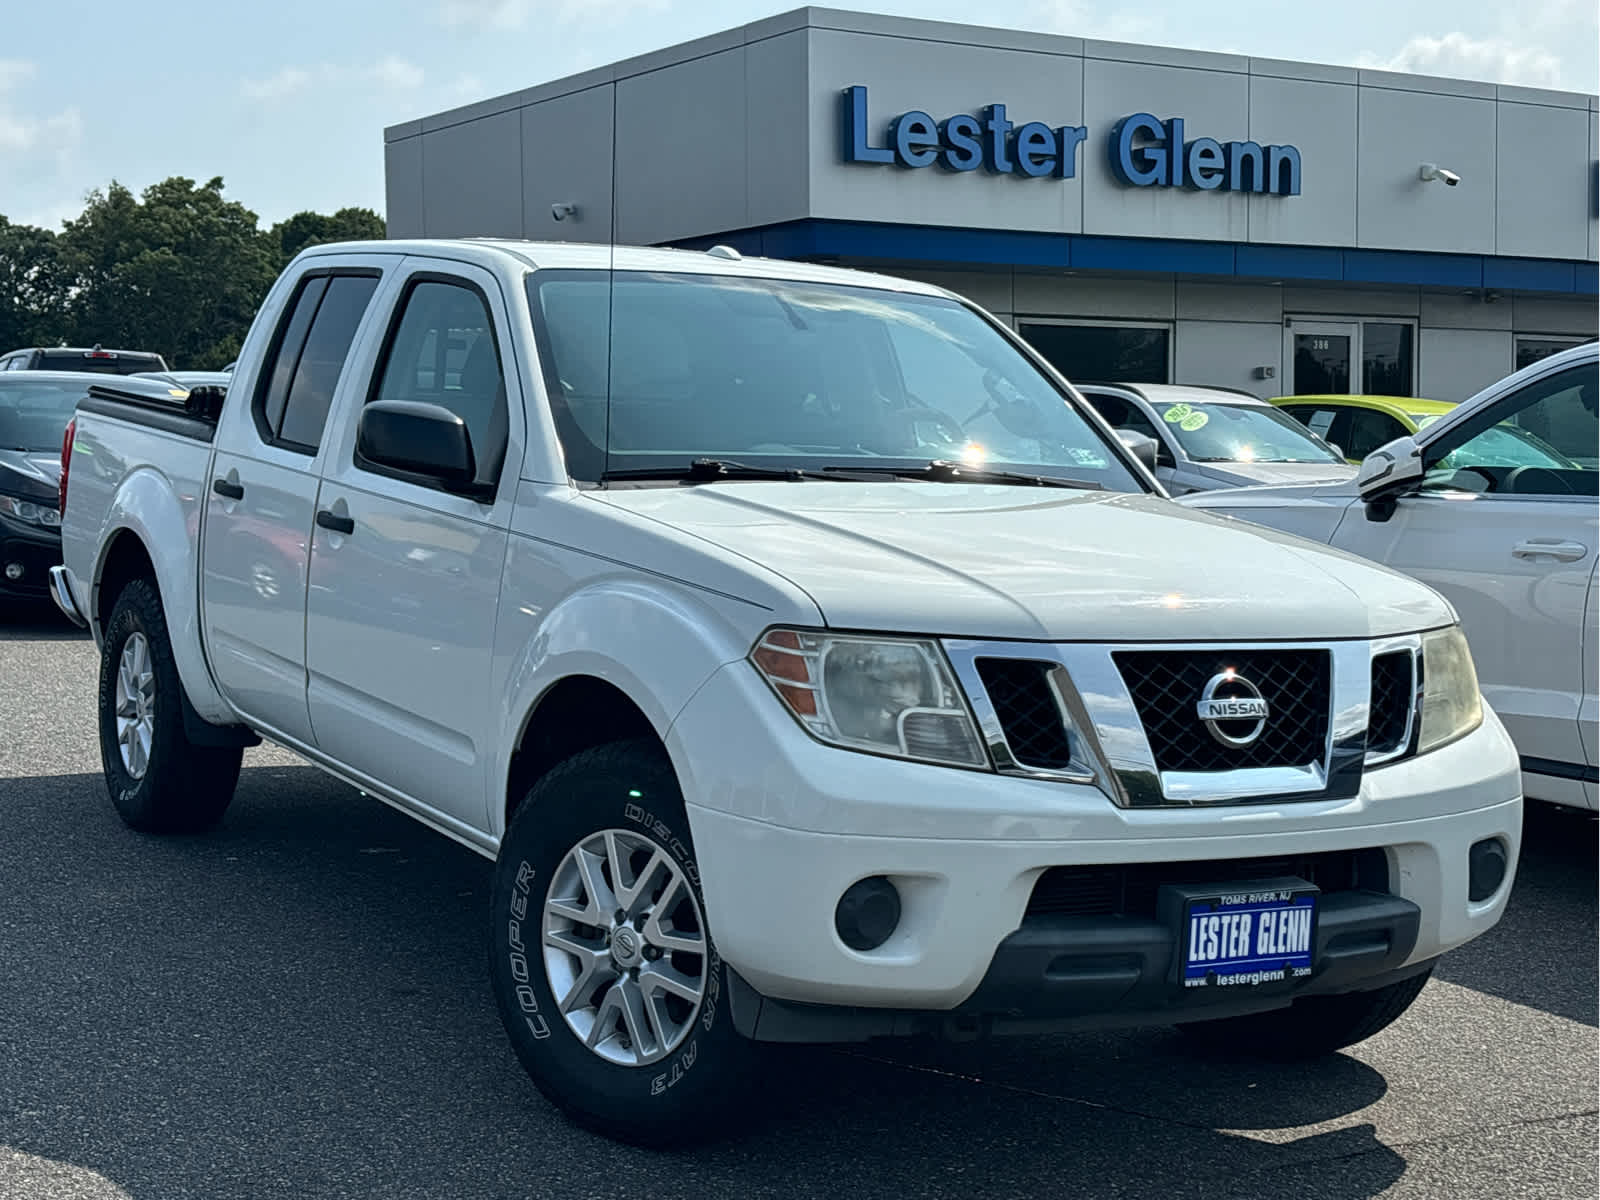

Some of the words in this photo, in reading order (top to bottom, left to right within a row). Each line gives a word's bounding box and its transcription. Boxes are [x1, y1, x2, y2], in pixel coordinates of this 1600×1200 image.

[842, 85, 1088, 180] Lester
[1109, 112, 1302, 197] Glenn
[1209, 703, 1266, 716] NISSAN
[1221, 895, 1247, 905] TOMS
[1280, 890, 1292, 901] NJ
[509, 860, 551, 1040] COOPER
[1189, 914, 1251, 961] LESTER
[1257, 909, 1312, 955] GLENN
[1216, 970, 1285, 986] lesterglenn
[651, 1040, 697, 1096] AT3
